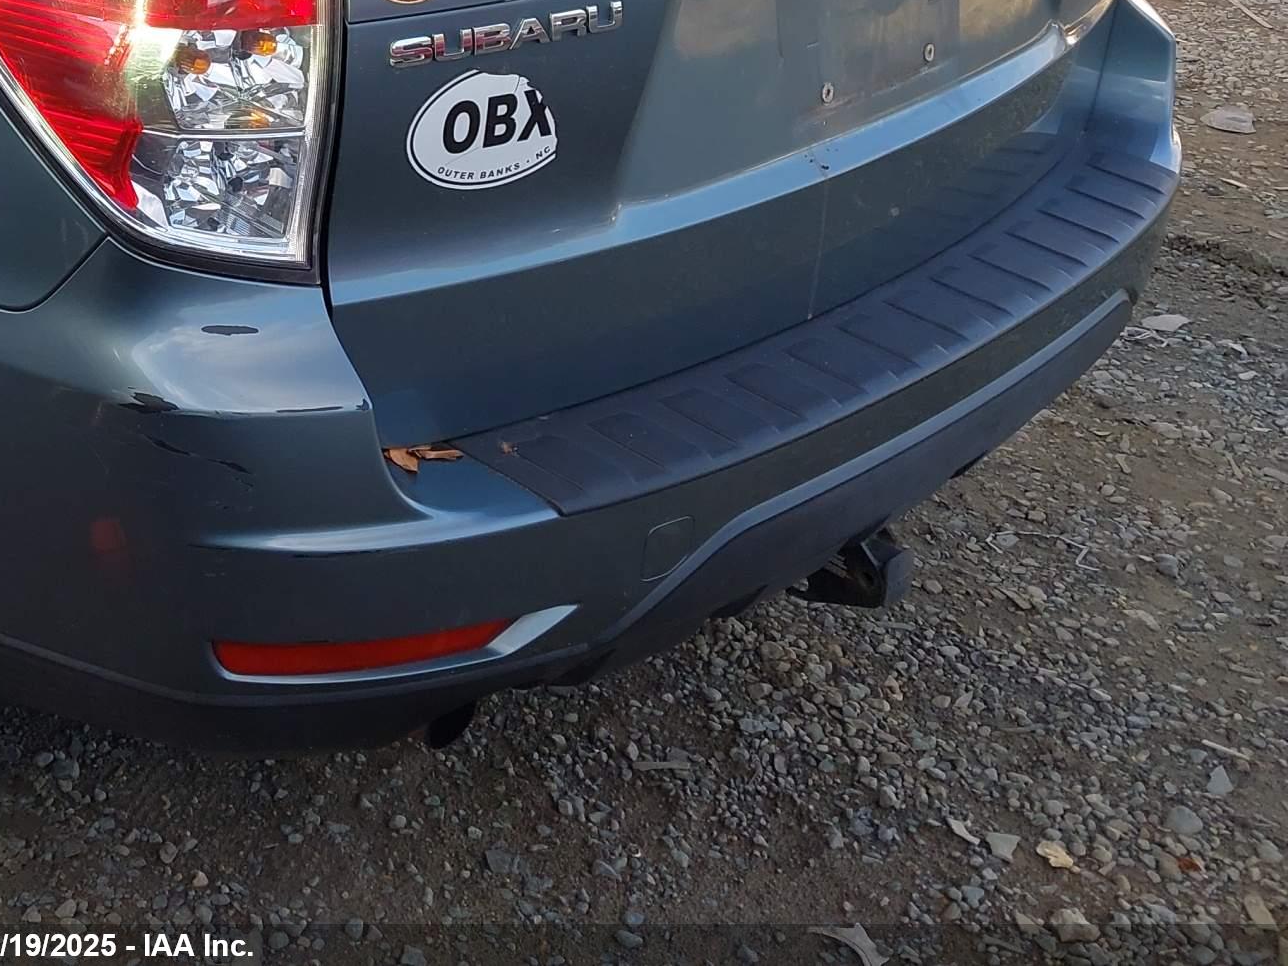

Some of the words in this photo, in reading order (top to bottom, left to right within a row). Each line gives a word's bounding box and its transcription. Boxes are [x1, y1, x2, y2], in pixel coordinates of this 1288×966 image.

[389, 0, 624, 68] SUBARU
[442, 89, 553, 155] OBX
[436, 165, 475, 181] OUTER
[479, 161, 521, 180] BANKS
[535, 145, 552, 160] NC
